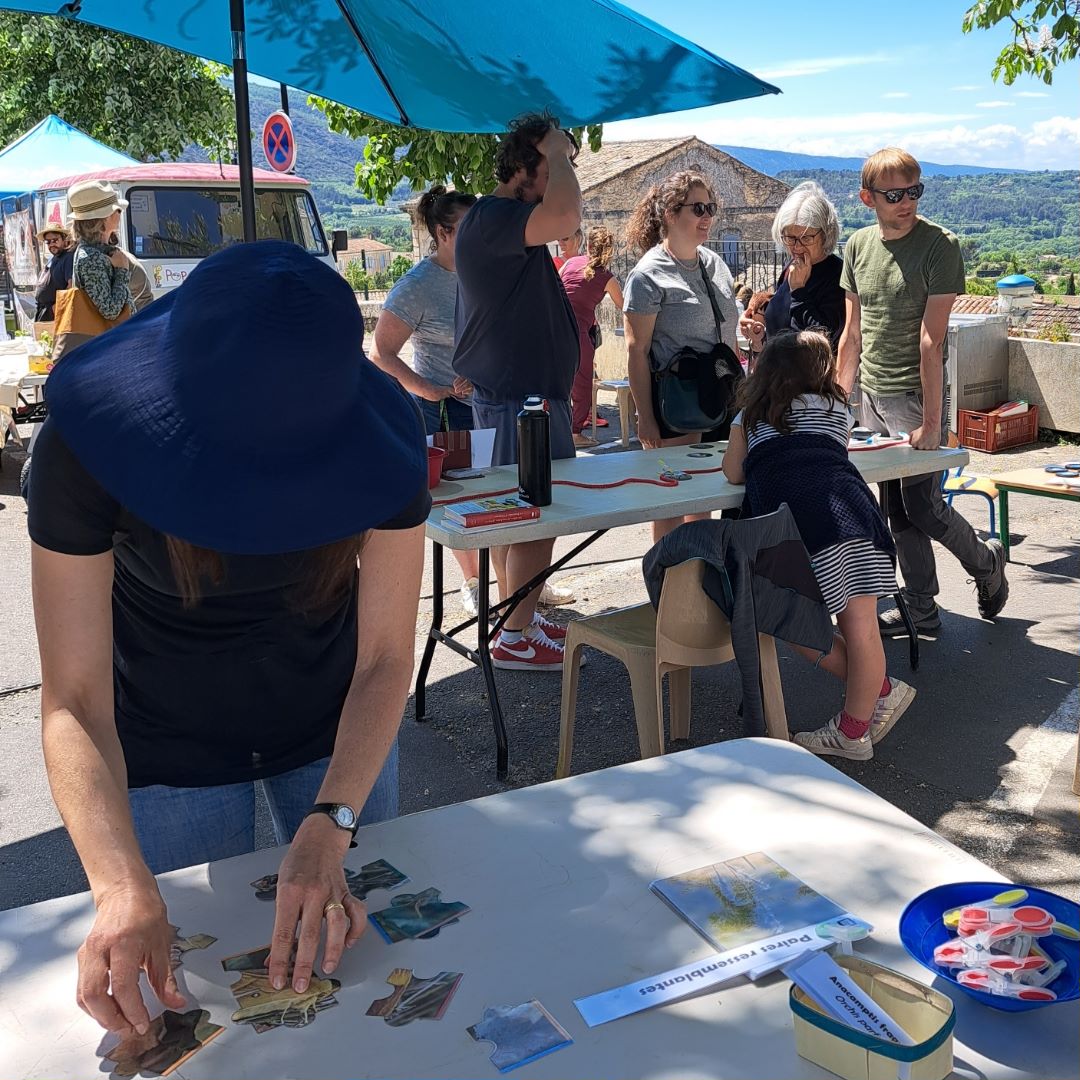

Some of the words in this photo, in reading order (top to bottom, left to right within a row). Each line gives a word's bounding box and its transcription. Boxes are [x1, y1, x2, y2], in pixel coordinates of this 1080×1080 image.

[760, 933, 813, 953] Paires
[638, 949, 757, 998] ressemblantes
[829, 975, 880, 1025] Anacamptis
[834, 994, 860, 1018] Orchis
